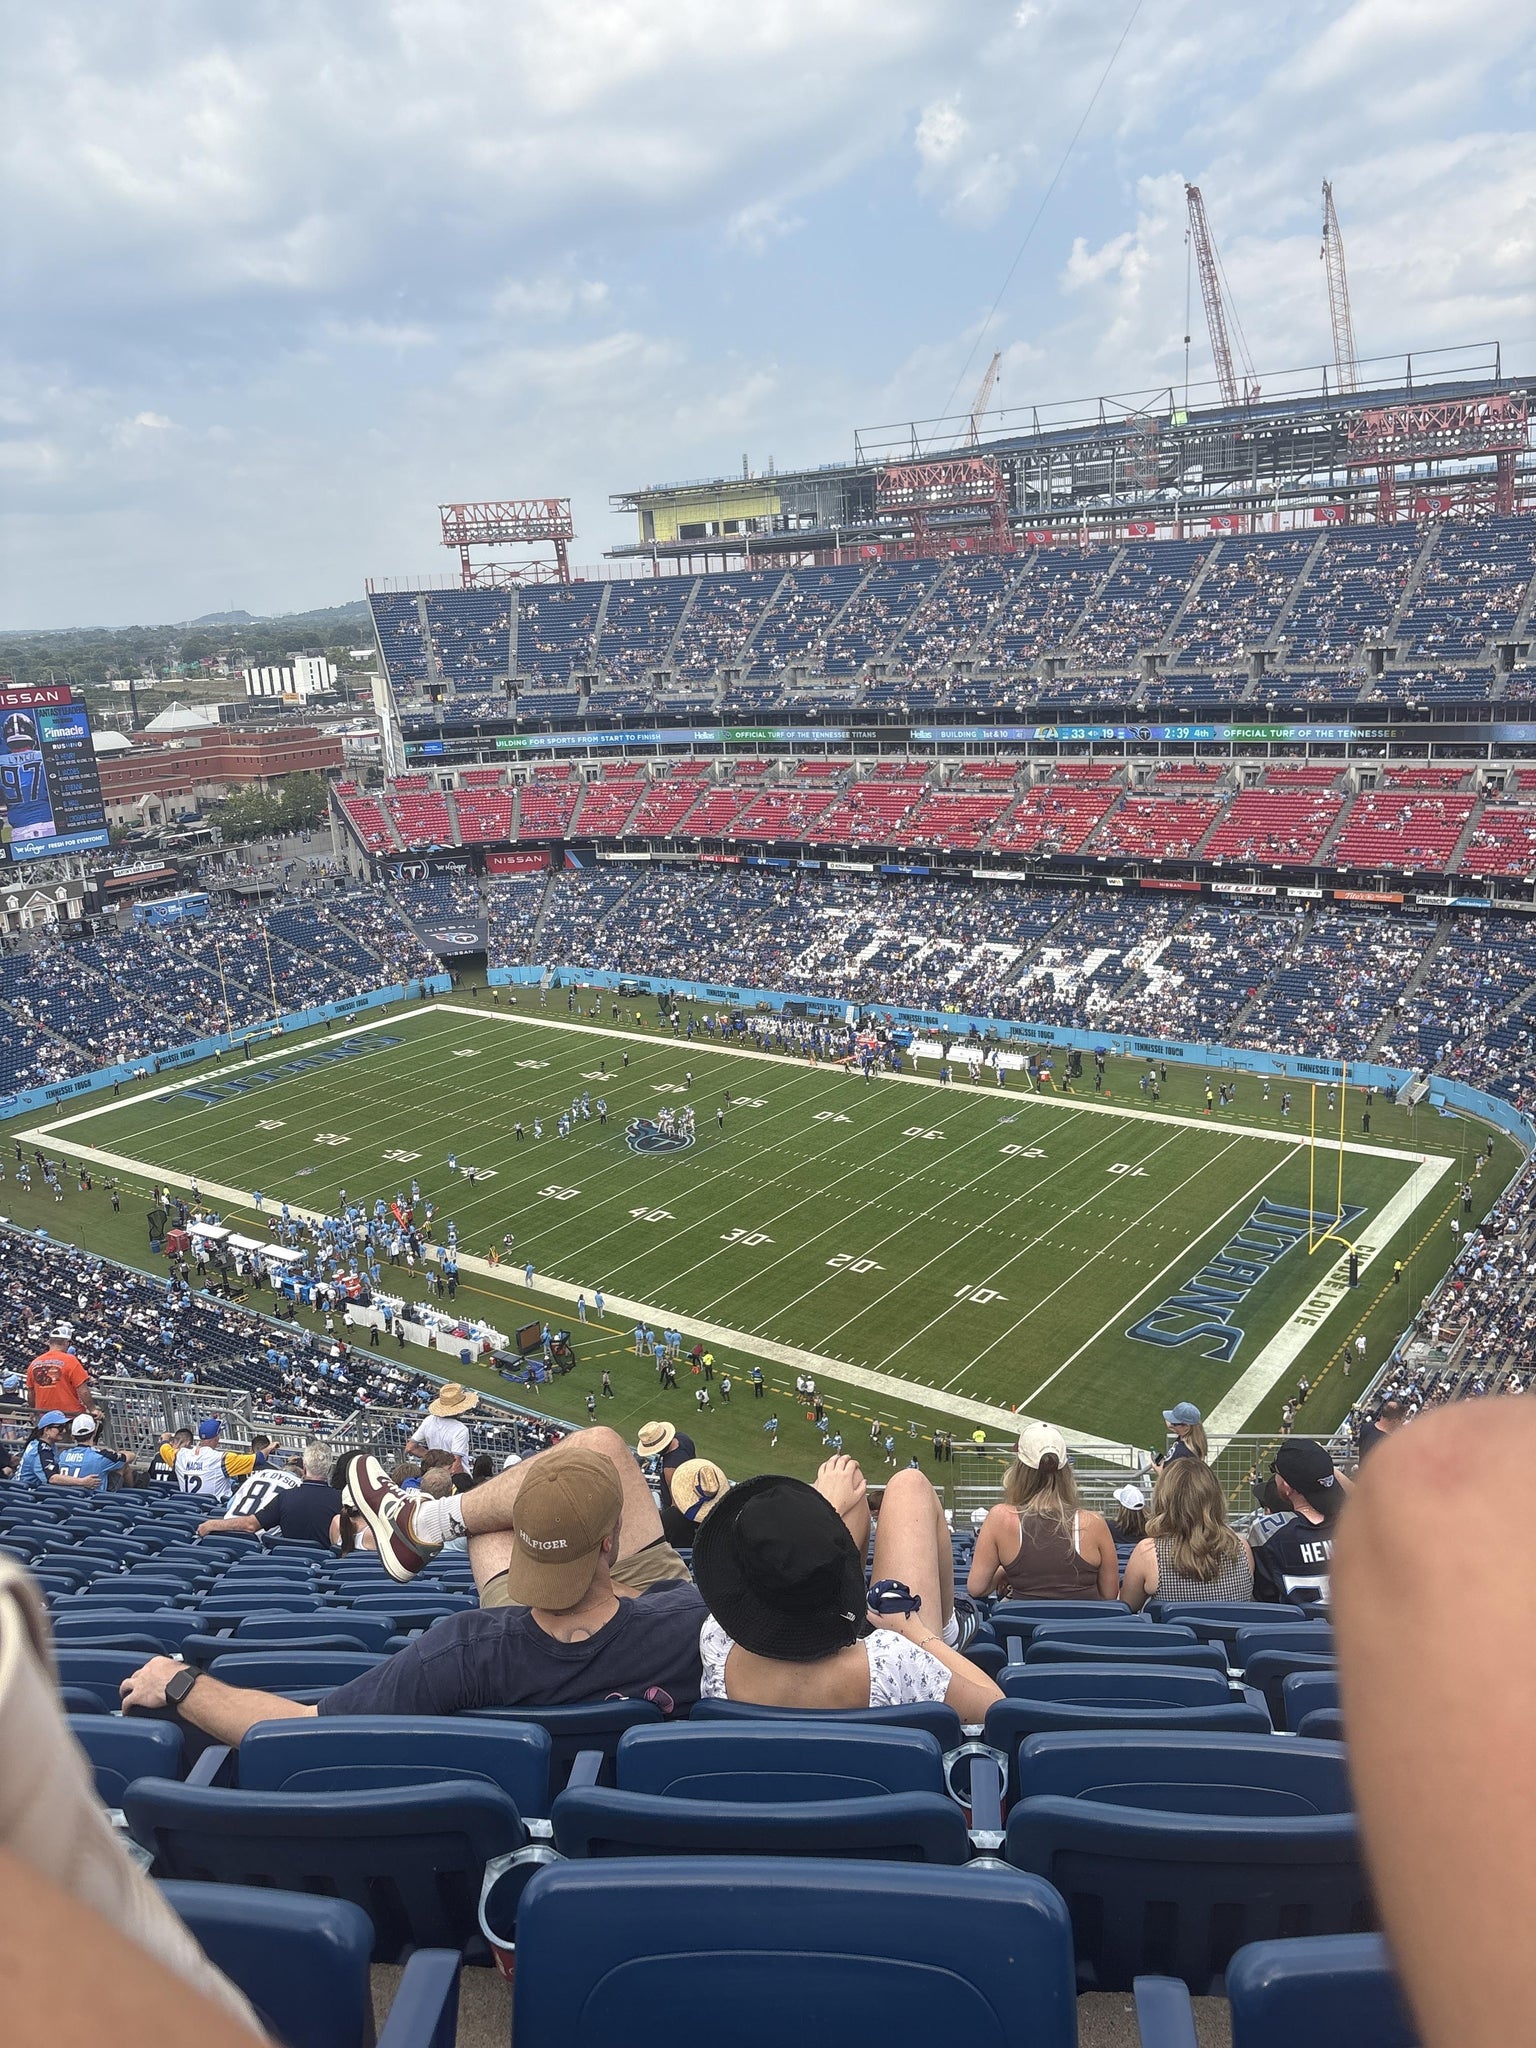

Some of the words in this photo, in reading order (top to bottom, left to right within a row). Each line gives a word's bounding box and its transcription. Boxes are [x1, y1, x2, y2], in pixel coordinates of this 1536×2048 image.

[0, 691, 59, 705] ISSAN
[44, 725, 84, 738] Pinnacle
[694, 731, 715, 740] Hellas
[735, 731, 766, 739] OFFICIAL
[768, 731, 785, 739] TURF
[786, 731, 796, 739] OF
[797, 731, 810, 739] THE
[812, 731, 850, 739] TENNESSEE
[851, 731, 877, 739] TITANS
[910, 730, 932, 739] Hellas
[941, 731, 977, 739] BUILDING
[1071, 728, 1085, 739] 33
[1102, 728, 1114, 739] 19
[1164, 728, 1189, 739] 2:39
[1195, 729, 1209, 738] 4th
[1223, 729, 1267, 738] OFFICIAL
[1270, 729, 1294, 738] TURF
[1298, 729, 1312, 738] OF
[1315, 729, 1334, 738] THE
[1337, 729, 1397, 738] TENNESSEE
[529, 738, 545, 746] FOR
[547, 736, 576, 745] SPORTS
[577, 735, 599, 744] FROM
[601, 734, 623, 743] START
[625, 733, 636, 741] TO
[637, 733, 661, 741] FINISH
[0, 761, 41, 804] 97
[48, 841, 64, 849] FRESH
[494, 855, 542, 865] NISSAN
[1417, 896, 1446, 904] Pinnacle
[335, 1002, 355, 1014] TENNESSEE
[356, 999, 369, 1008] TOUGH
[899, 1013, 923, 1024] TENNESSEE
[924, 1016, 939, 1025] TOUGH
[1010, 1027, 1037, 1039] TENNESSEE
[1038, 1029, 1054, 1040] TOUGH
[179, 1049, 195, 1060] TOUGH
[1134, 1042, 1163, 1054] TENNESSEE
[1165, 1044, 1183, 1057] TOUGH
[155, 1033, 406, 1107] TITANS
[1297, 1062, 1330, 1075] TENNESSEE
[45, 1083, 74, 1099] TENNESSEE
[75, 1079, 91, 1092] TOUGH
[316, 1133, 352, 1146] 20
[385, 1149, 422, 1163] 30
[537, 1185, 582, 1200] 50
[628, 1207, 671, 1222] 40
[719, 1228, 768, 1246] 30
[825, 1253, 878, 1273] 20
[1125, 1196, 1368, 1363] TITANS
[953, 1284, 999, 1304] 10
[1294, 1292, 1338, 1327] LOVE
[65, 1453, 84, 1463] DAVIS
[183, 1474, 203, 1494] 12
[519, 1529, 568, 1550] HILFIGER
[1300, 1540, 1333, 1563] HEN
